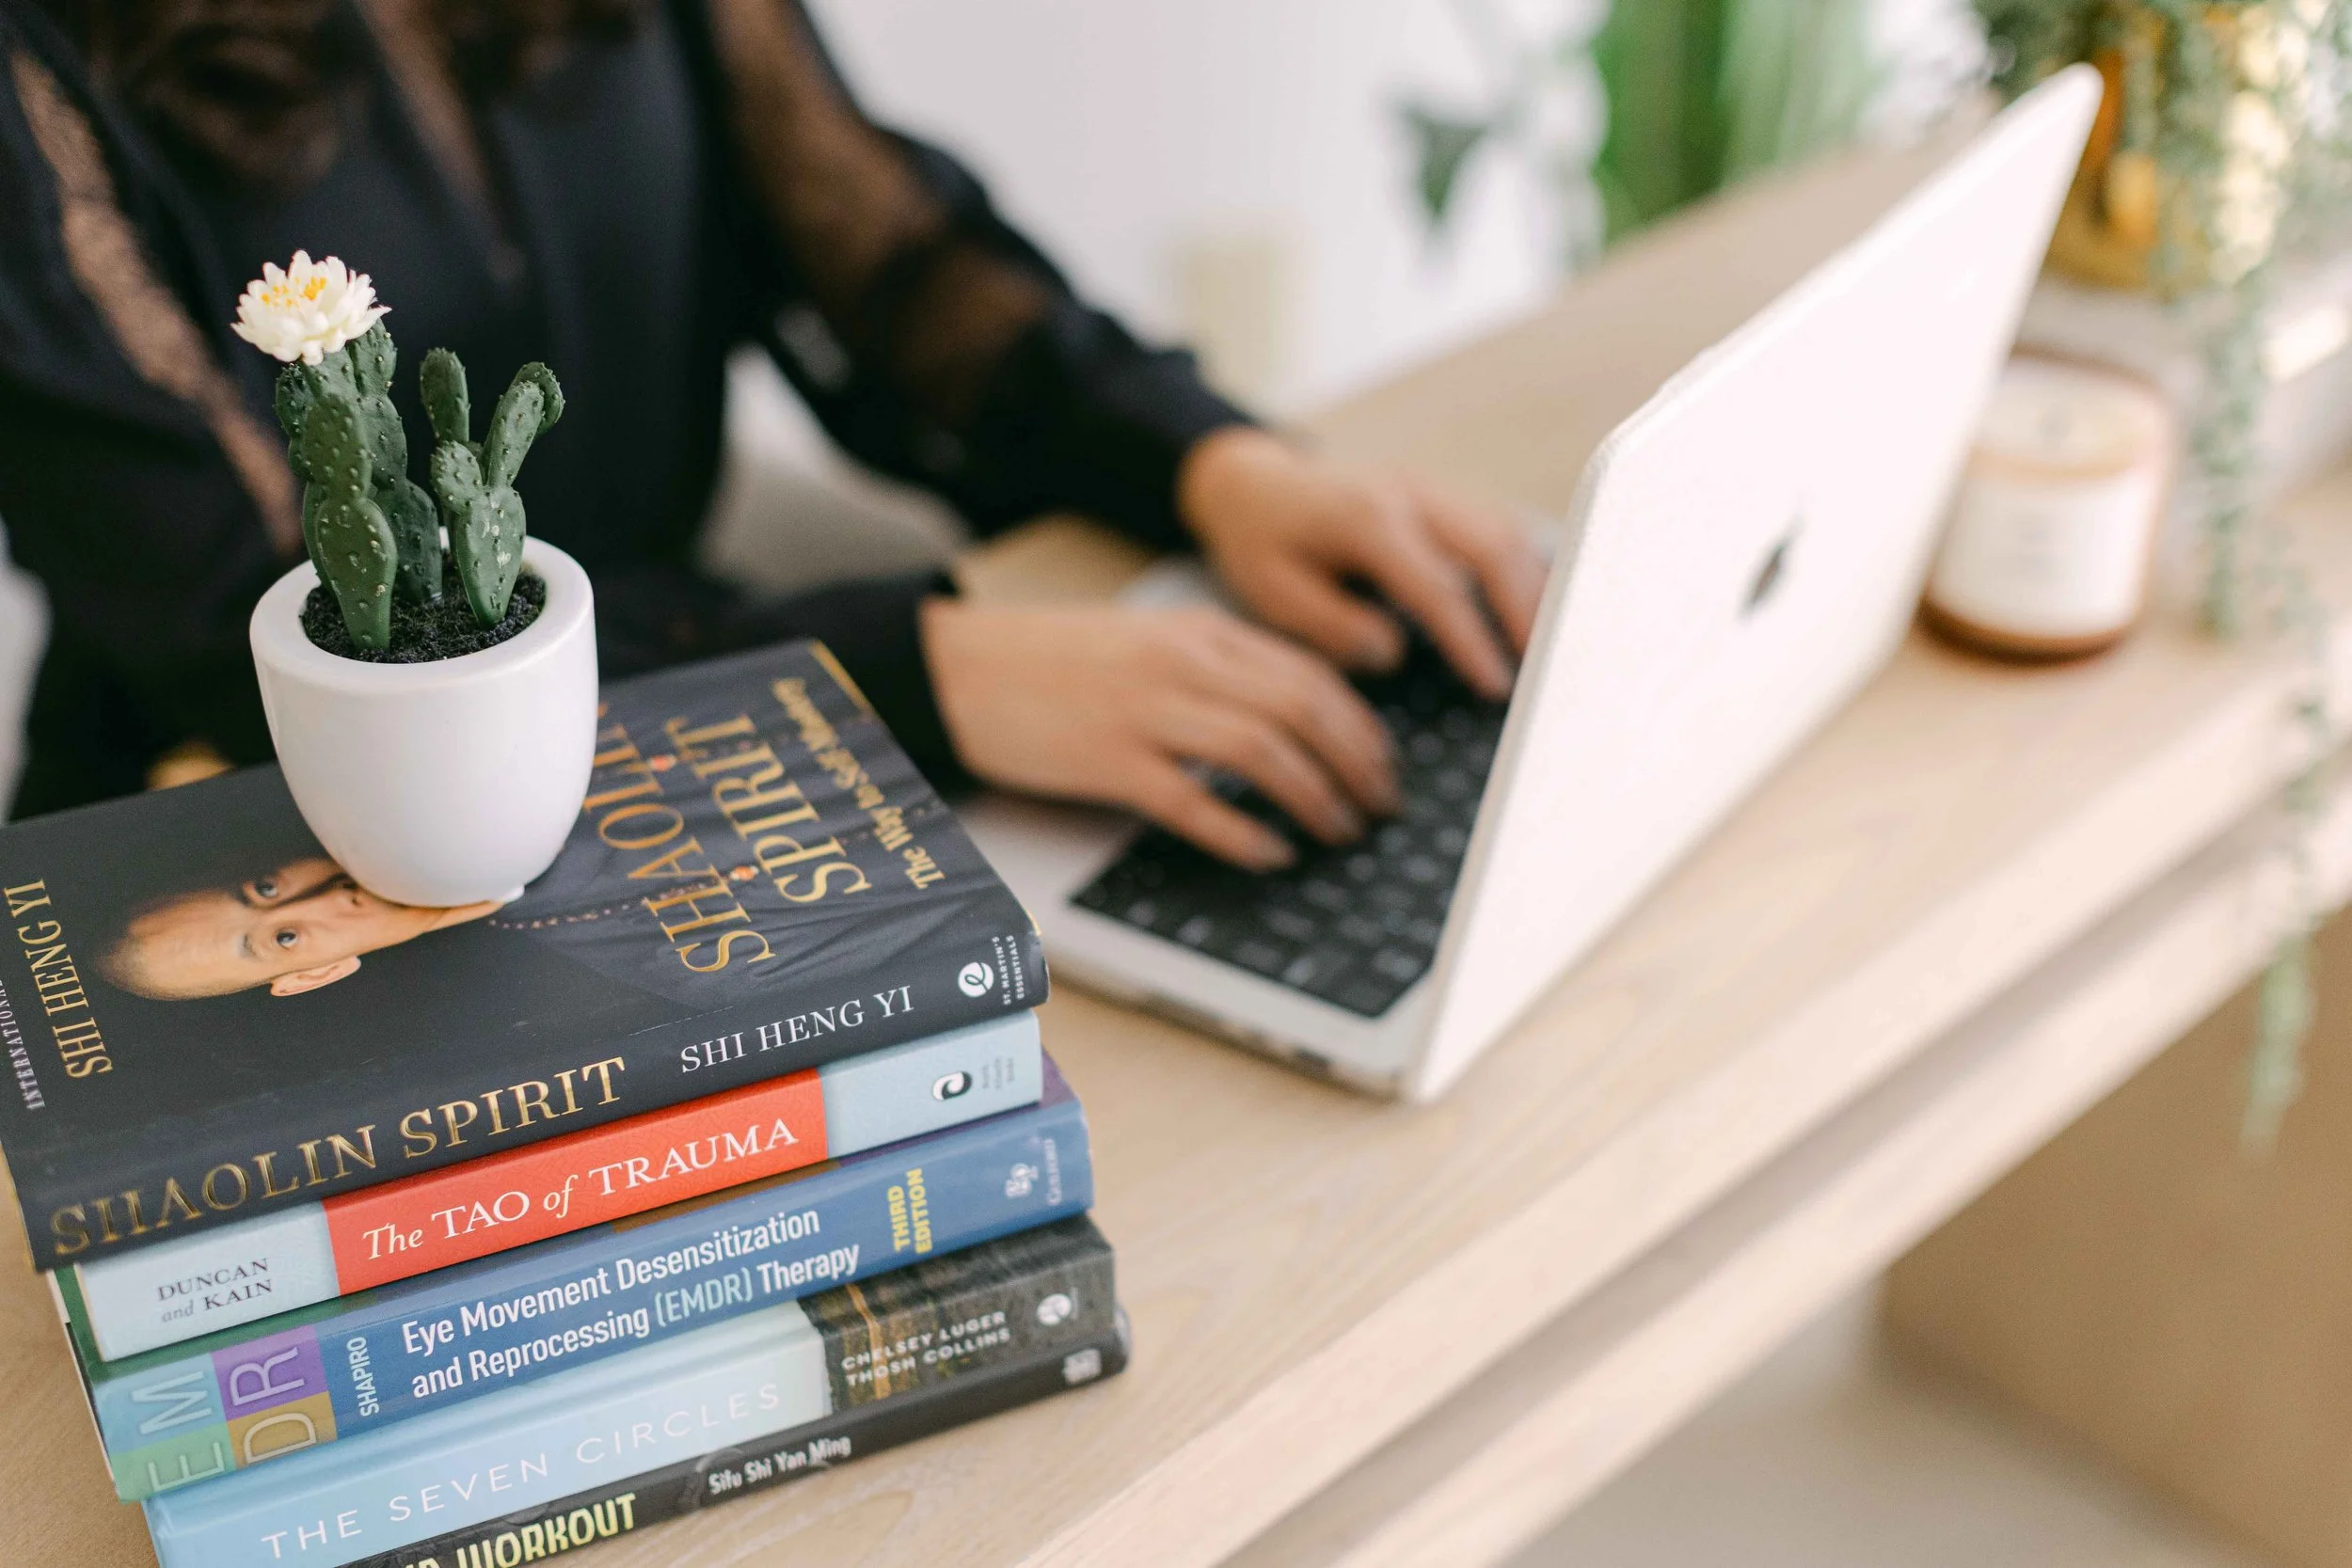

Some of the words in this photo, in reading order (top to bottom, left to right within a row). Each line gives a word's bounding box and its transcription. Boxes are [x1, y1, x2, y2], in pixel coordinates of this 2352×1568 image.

[665, 713, 872, 903] SPIRIT
[3, 878, 52, 918] YI
[902, 846, 946, 890] The
[18, 919, 89, 1017] HENG
[1006, 935, 1025, 1000] ESSENTIALS
[51, 1016, 114, 1078] SHI
[50, 1123, 377, 1256] SHAOLIN
[399, 1056, 626, 1159] SPIRIT
[680, 1031, 748, 1073] SHI
[755, 999, 865, 1053] HENG
[873, 985, 914, 1019] YI
[361, 1222, 424, 1260] The
[430, 1190, 530, 1239] TAO
[543, 1173, 580, 1220] of
[588, 1117, 800, 1197] TRAUMA
[887, 1185, 911, 1253] THIRD
[906, 1167, 933, 1254] EDITION
[157, 1258, 271, 1302] DUNCAN
[161, 1300, 195, 1323] and
[203, 1278, 273, 1311] KAIN
[402, 1318, 455, 1358] Eye
[459, 1266, 611, 1339] Movement
[614, 1208, 821, 1292] Desensitization
[411, 1356, 464, 1400] and
[468, 1306, 651, 1384] Reprocessing
[654, 1268, 754, 1329] (EMDR)
[755, 1243, 860, 1297] Therapy
[841, 1332, 934, 1370] CHELSEY
[938, 1310, 1006, 1341] LUGER
[846, 1355, 916, 1386] THOSH
[923, 1327, 1011, 1364] COLLINS
[345, 1336, 380, 1418] SHAPIRO
[260, 1508, 364, 1560] THE
[387, 1451, 548, 1522] SEVEN
[575, 1383, 781, 1465] CIRCLES
[707, 1468, 743, 1496] Sifu
[743, 1457, 773, 1483] Shi
[773, 1449, 806, 1473] Yan
[455, 1492, 637, 1568] WORKOUT
